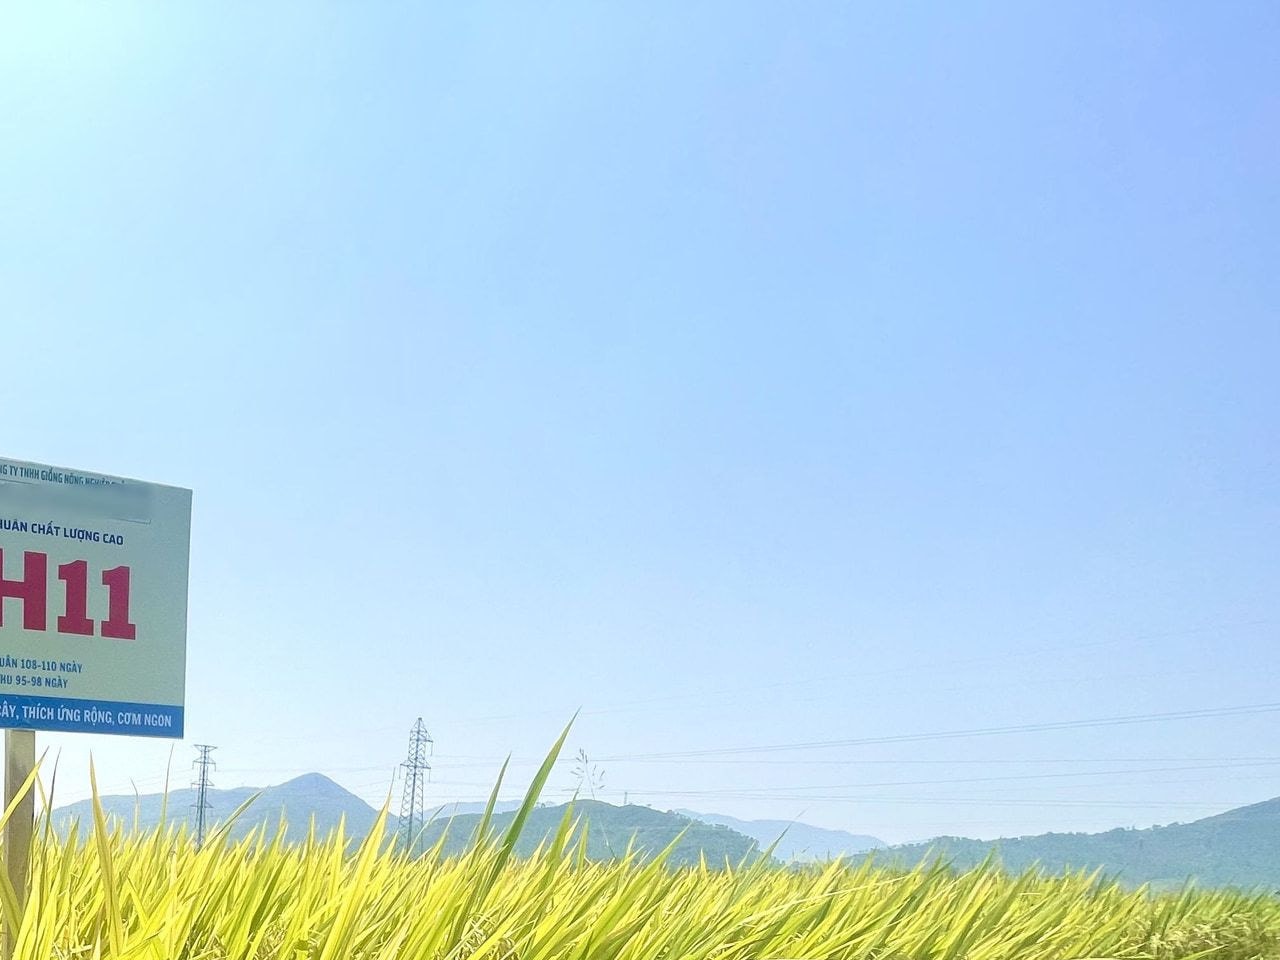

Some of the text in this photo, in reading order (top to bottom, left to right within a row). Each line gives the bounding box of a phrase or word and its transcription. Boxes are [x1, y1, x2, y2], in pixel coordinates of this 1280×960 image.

[9, 465, 19, 477] TY
[31, 520, 61, 537] CHẤT
[63, 527, 100, 543] LƯỢNG
[102, 533, 124, 546] CAO
[21, 659, 58, 672] 108-110
[59, 660, 83, 674] NGÀY
[15, 675, 43, 687] 95-98
[44, 675, 69, 689] NGÀY
[22, 703, 54, 720] THÍCH
[57, 704, 81, 722] ỨNG
[83, 705, 115, 726] RỘNG,
[117, 711, 142, 726] CƠM
[144, 713, 172, 728] NGON
